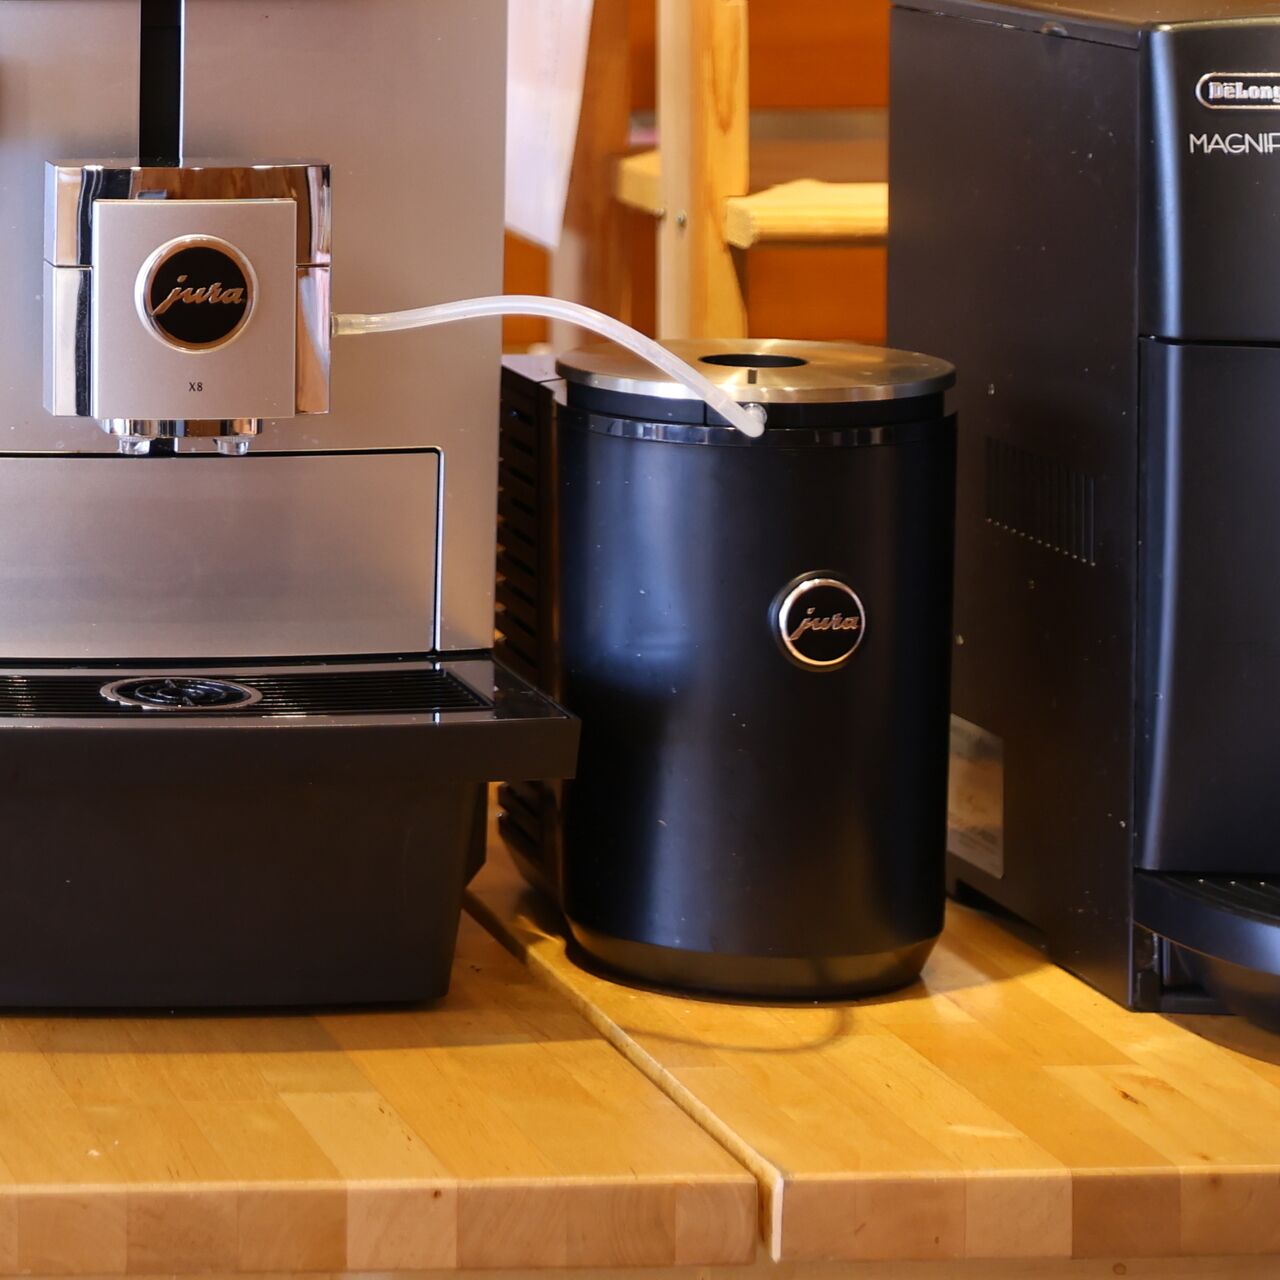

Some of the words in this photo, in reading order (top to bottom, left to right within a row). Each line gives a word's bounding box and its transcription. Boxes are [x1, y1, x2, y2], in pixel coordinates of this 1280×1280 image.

[151, 274, 244, 316] jura
[188, 381, 204, 393] X8
[789, 607, 860, 641] jura
